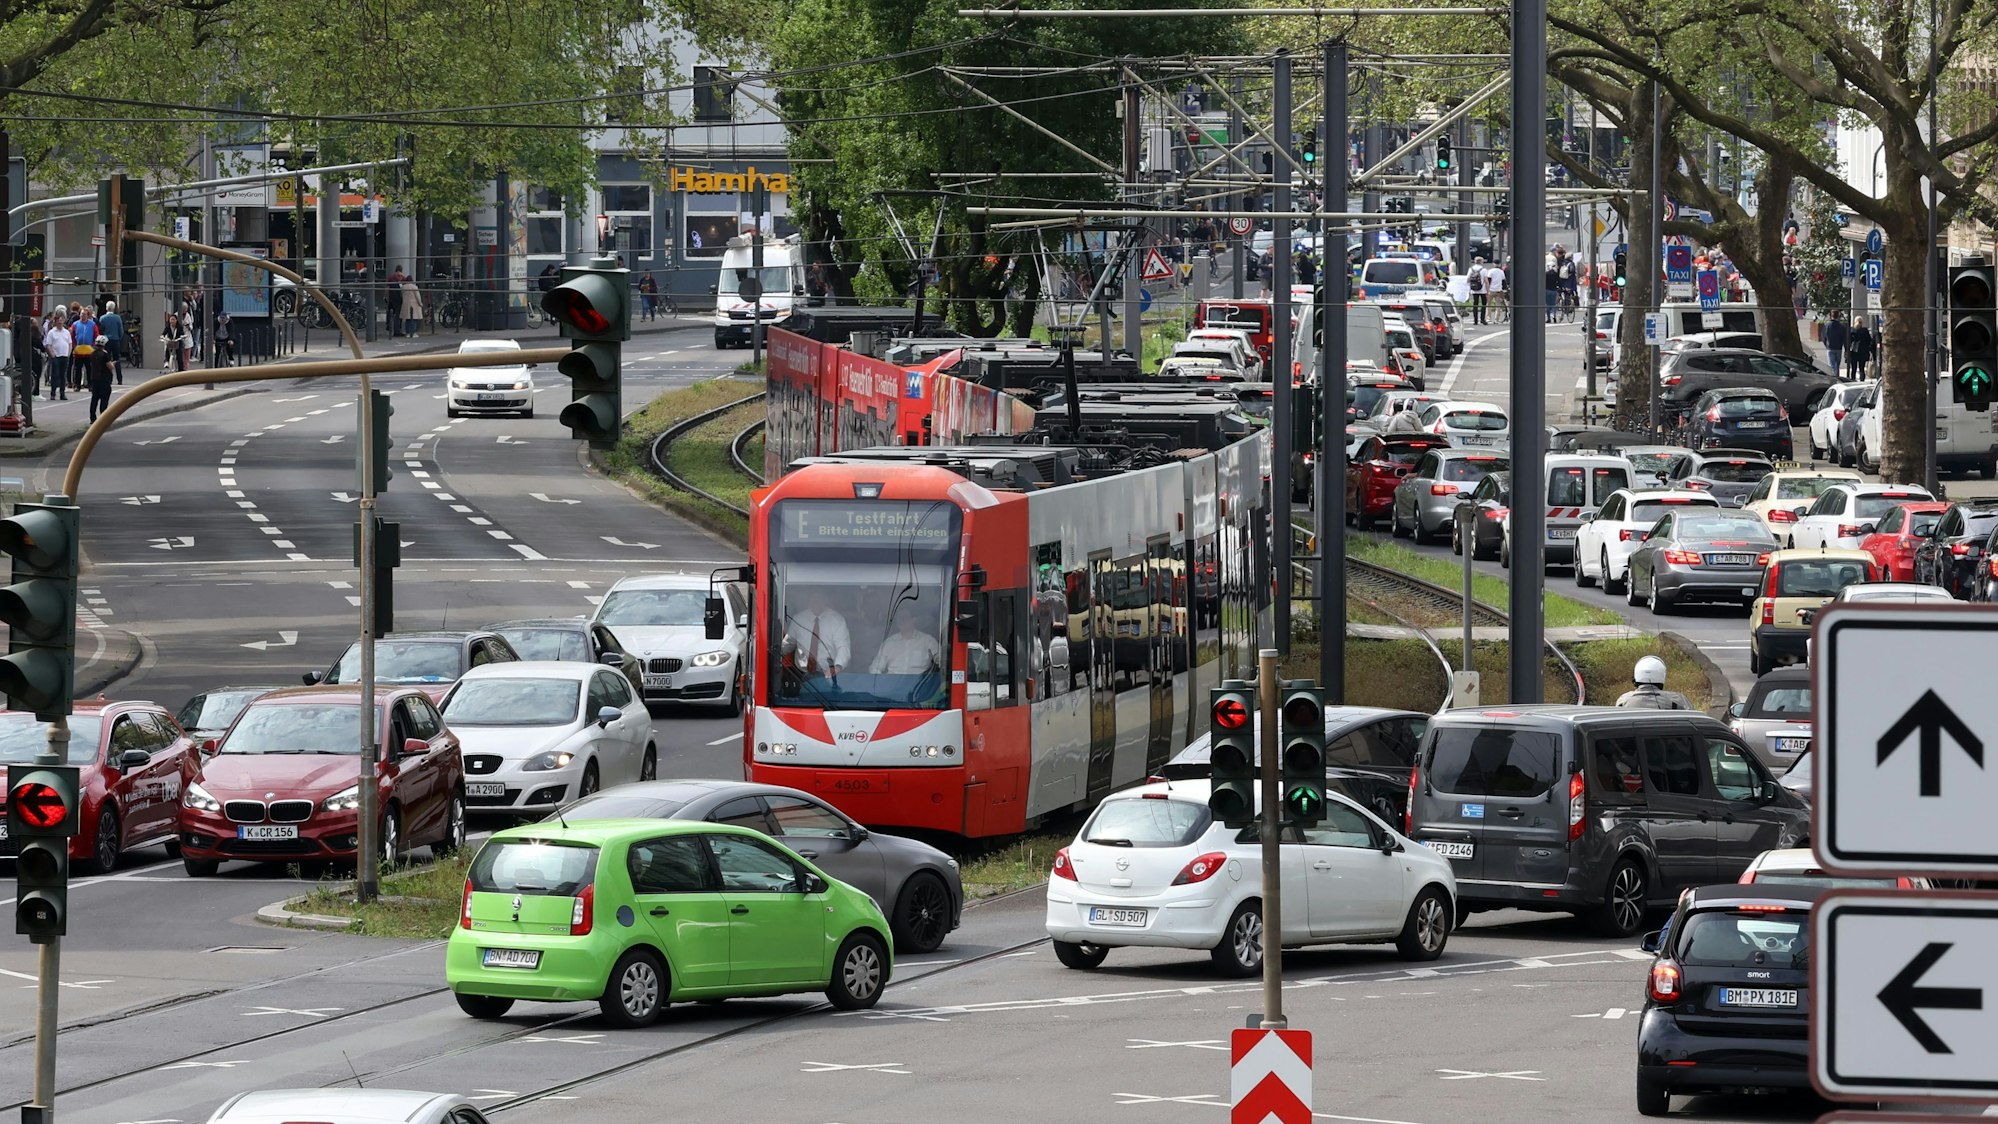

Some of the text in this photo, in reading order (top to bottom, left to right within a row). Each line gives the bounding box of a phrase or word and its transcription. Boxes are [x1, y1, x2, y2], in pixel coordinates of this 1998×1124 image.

[1235, 218, 1247, 228] 30
[1843, 260, 1852, 275] P
[1669, 270, 1689, 279] TAXI
[1869, 263, 1878, 286] P
[1702, 298, 1719, 308] TAXI
[846, 511, 920, 525] Testfahrt
[798, 511, 809, 539] E
[818, 525, 947, 538] Bitte nicht einsteigen
[652, 677, 670, 685] 7000
[838, 732, 856, 740] KVB
[1781, 739, 1805, 749] K AB
[482, 785, 503, 794] 2900
[834, 779, 870, 790] 4503
[247, 827, 293, 838] K CR 156
[1435, 843, 1448, 854] FD
[1449, 844, 1472, 856] 2146
[1095, 909, 1146, 922] GL SD 507
[489, 950, 537, 963] BN AD 700
[1747, 971, 1771, 979] smart
[1727, 990, 1796, 1004] BM PX 181E
